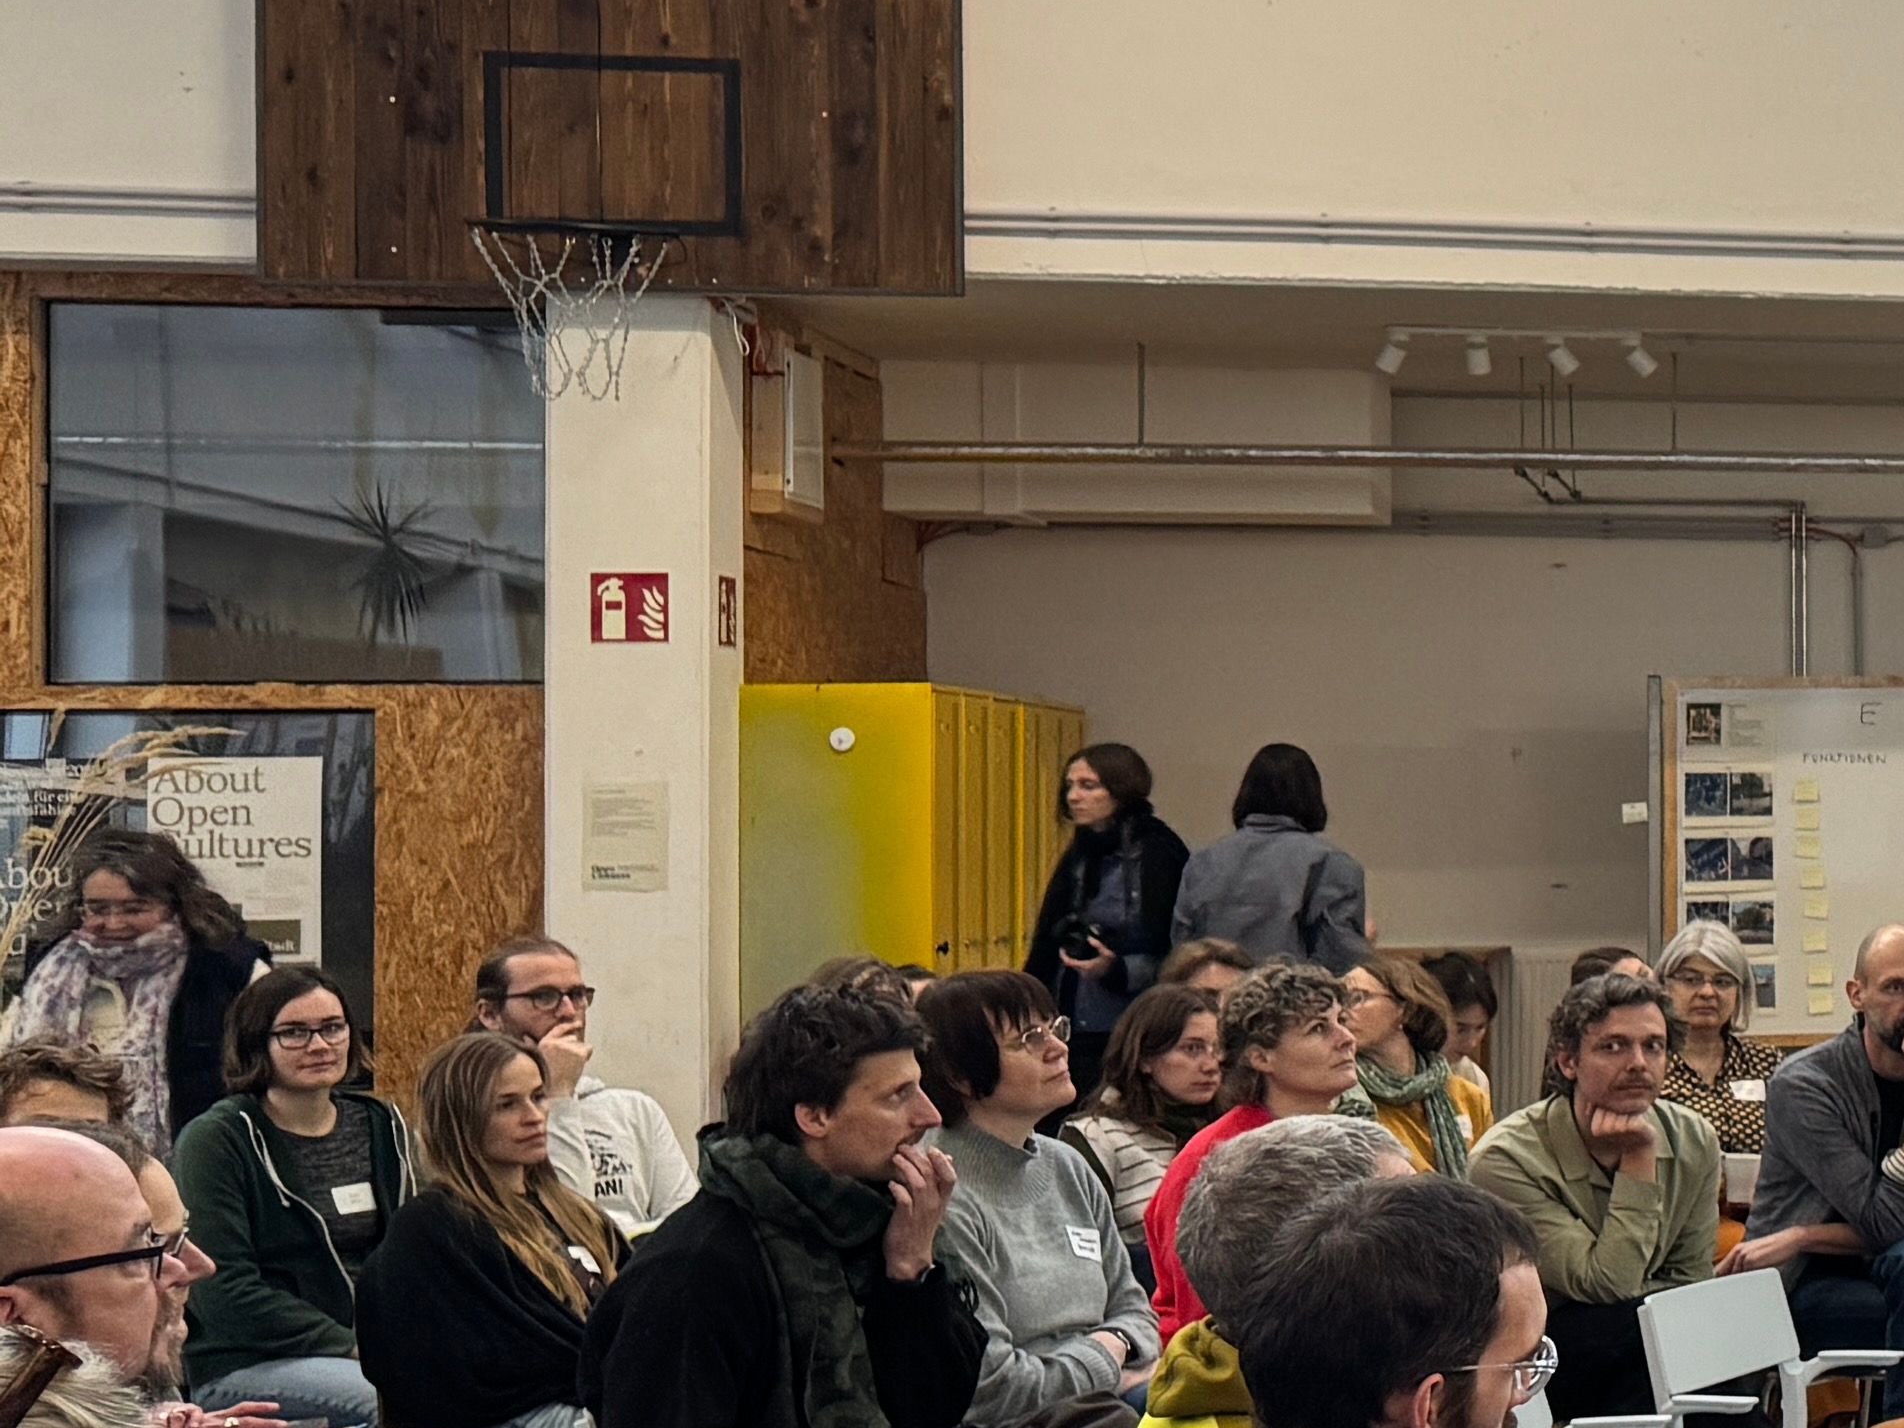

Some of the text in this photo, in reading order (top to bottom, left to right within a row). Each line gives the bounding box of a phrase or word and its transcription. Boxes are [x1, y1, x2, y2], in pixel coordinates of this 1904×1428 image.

[153, 766, 267, 794] About
[152, 797, 255, 835] Open
[162, 829, 312, 860] ultures
